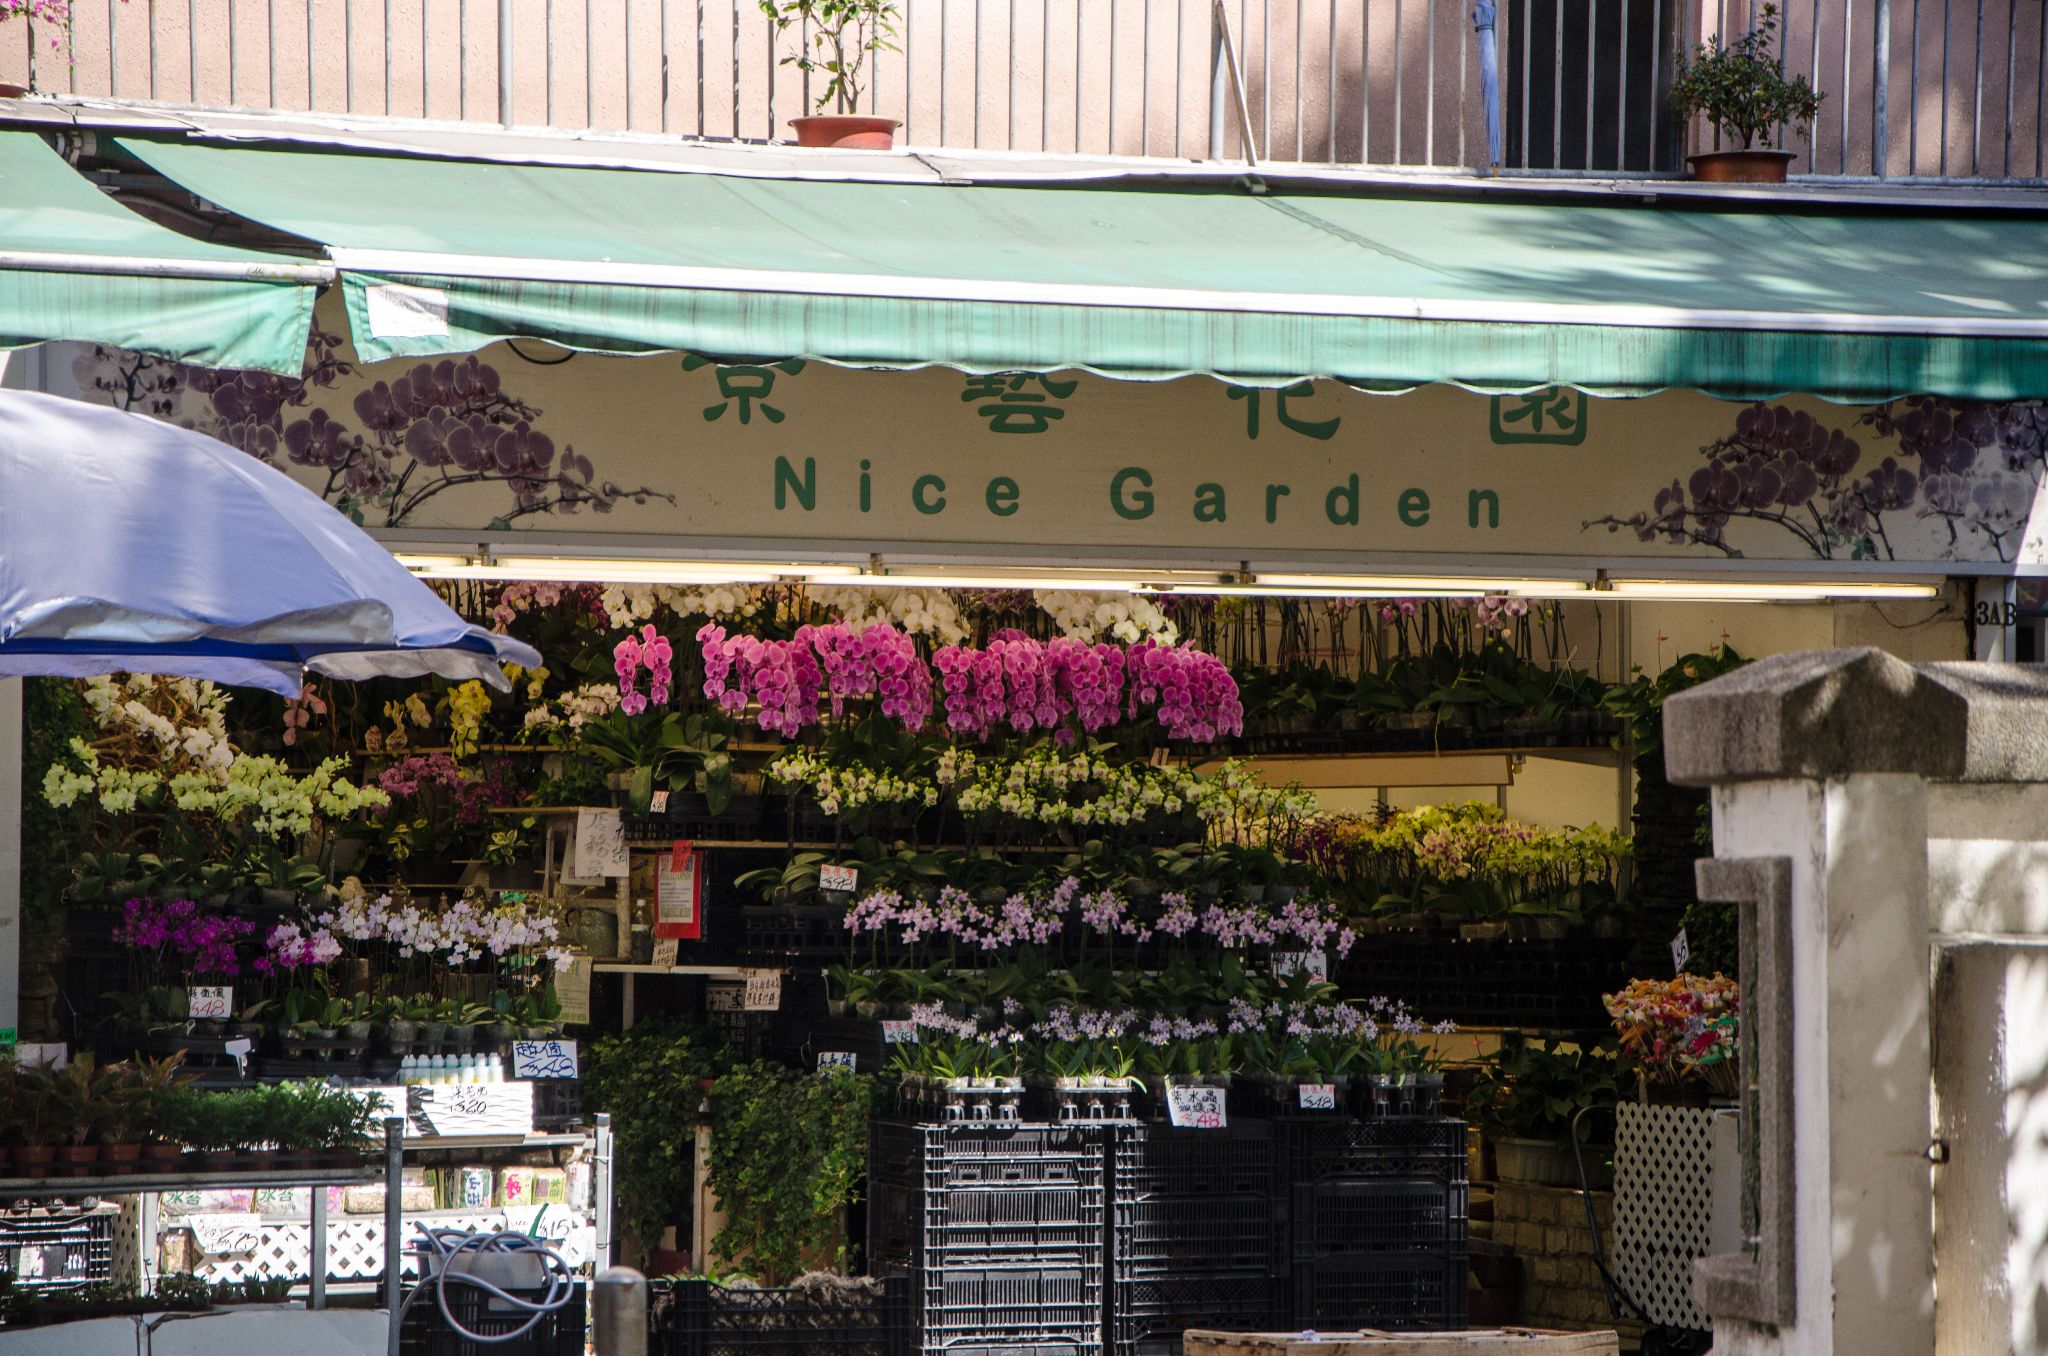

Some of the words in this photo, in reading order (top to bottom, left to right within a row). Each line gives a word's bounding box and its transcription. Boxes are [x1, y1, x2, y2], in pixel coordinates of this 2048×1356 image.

[775, 456, 1020, 516] Nice
[1110, 466, 1500, 529] Garden
[1976, 601, 2016, 626] 3AB
